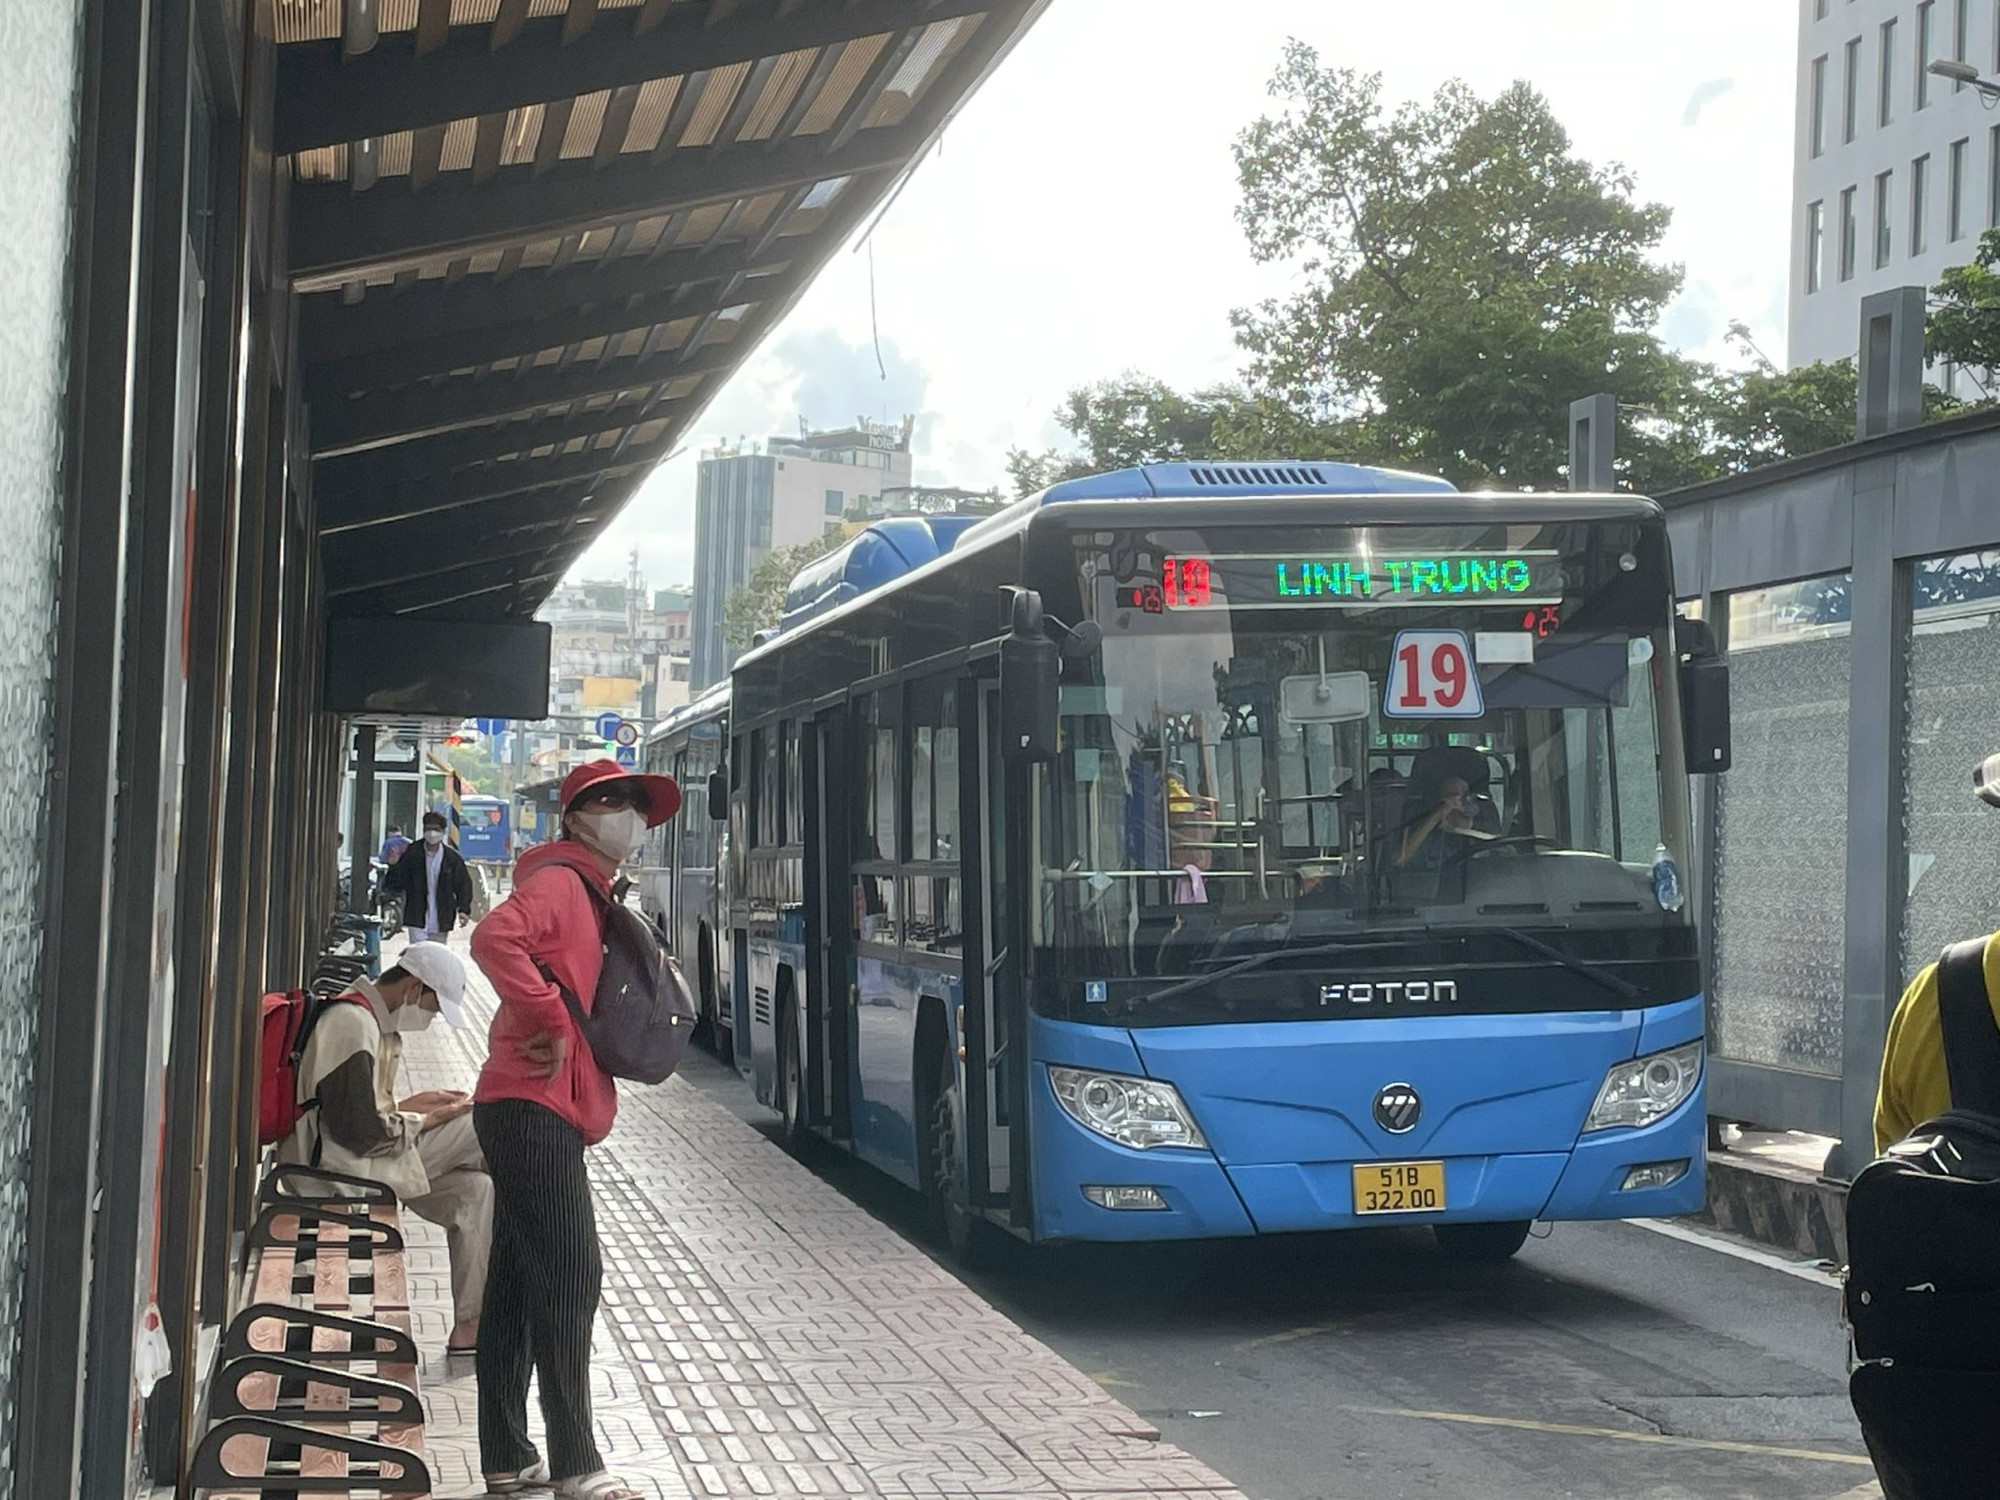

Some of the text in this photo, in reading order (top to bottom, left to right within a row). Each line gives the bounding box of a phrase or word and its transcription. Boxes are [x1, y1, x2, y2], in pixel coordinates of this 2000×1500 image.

[1277, 562, 1371, 596] LINH
[1384, 560, 1530, 594] TRUNG
[1398, 643, 1467, 708] 19
[1320, 981, 1457, 1005] FOTON
[1380, 1167, 1418, 1187] 51B
